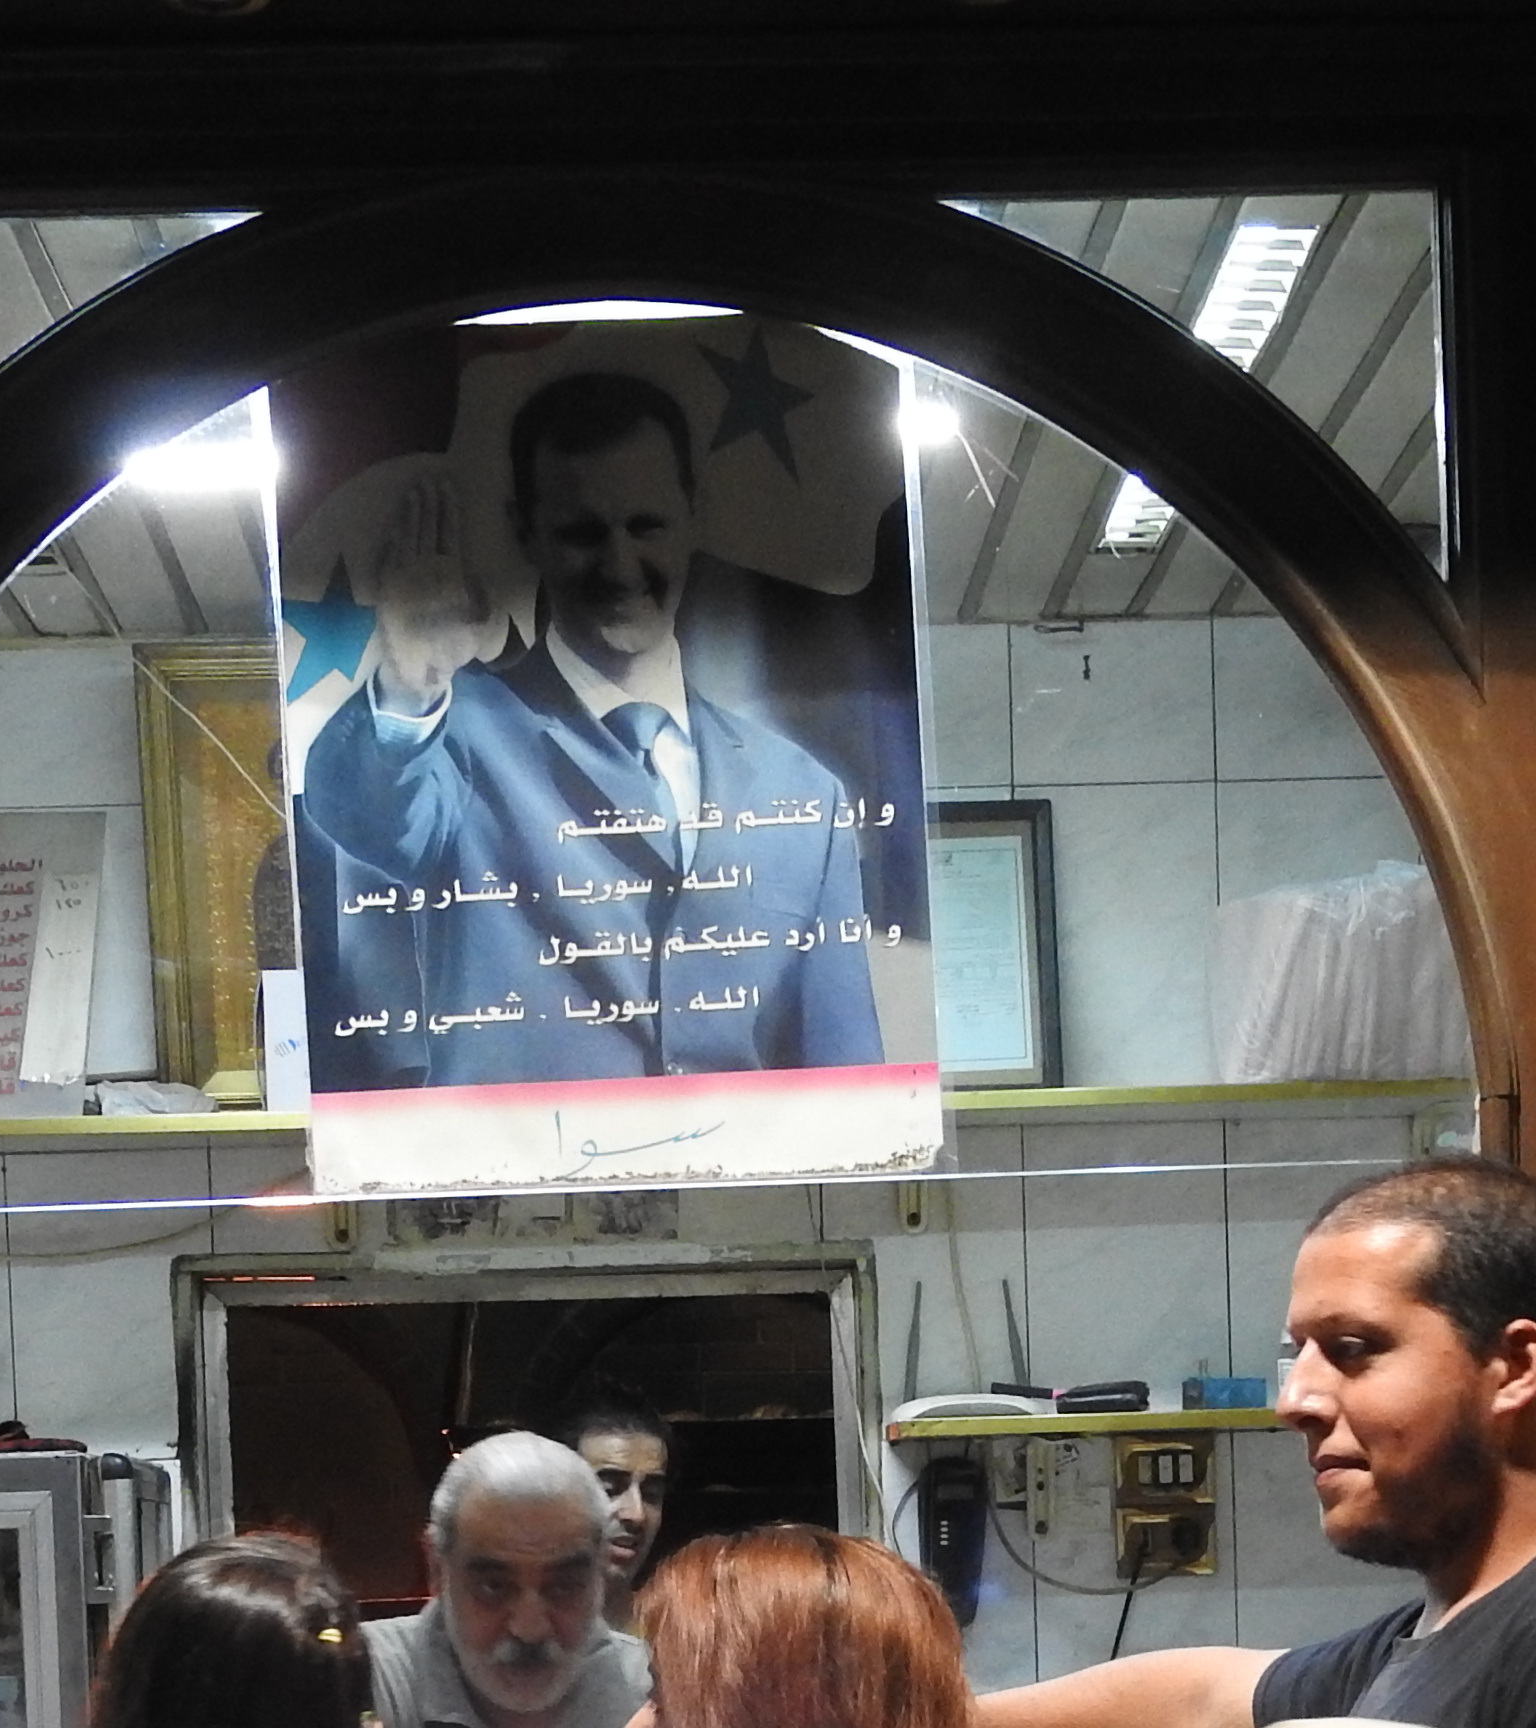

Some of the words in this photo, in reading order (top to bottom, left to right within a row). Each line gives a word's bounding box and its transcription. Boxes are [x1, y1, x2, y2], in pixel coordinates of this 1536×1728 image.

[557, 807, 667, 843] هتفتم
[680, 803, 724, 830] قد
[735, 799, 822, 834] كنتم
[433, 870, 520, 909] بشار
[538, 924, 652, 966] بالقول
[663, 925, 771, 960] عليكم
[784, 916, 826, 951] أرد
[427, 990, 525, 1037] شعبي
